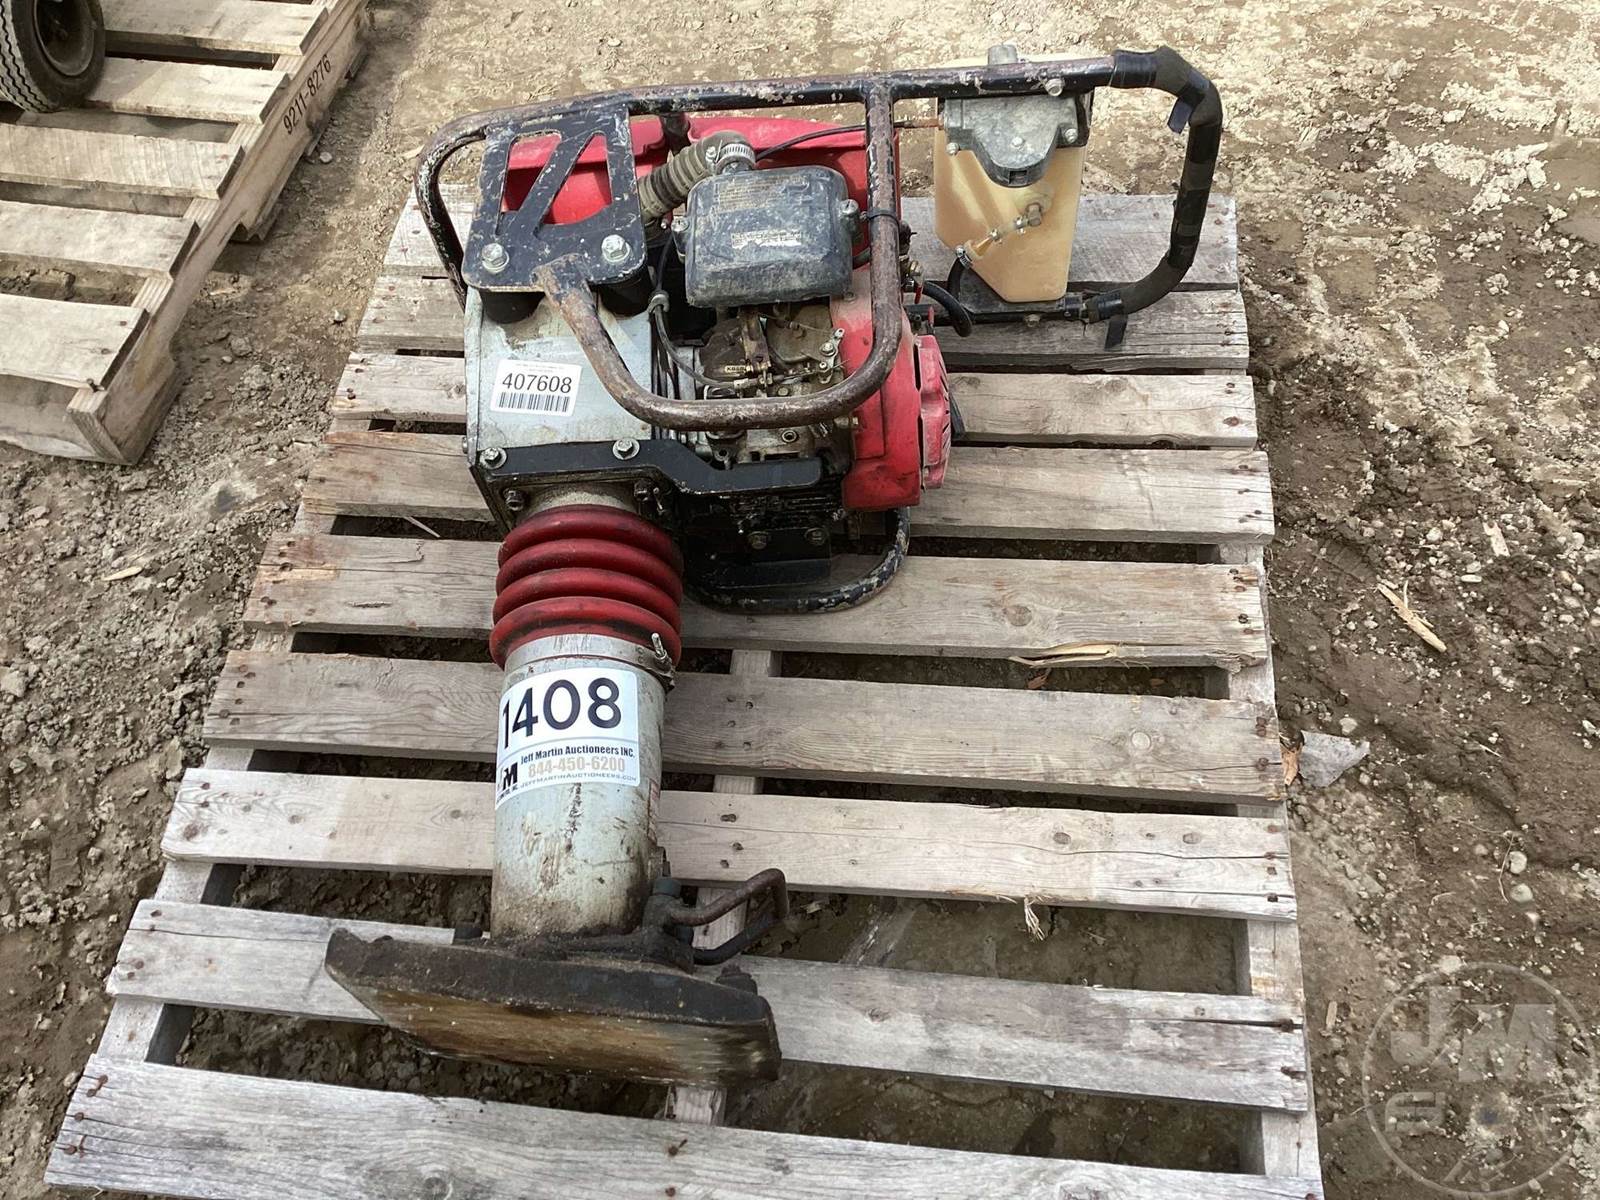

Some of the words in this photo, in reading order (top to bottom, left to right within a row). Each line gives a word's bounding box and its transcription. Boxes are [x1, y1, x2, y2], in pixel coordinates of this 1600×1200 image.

[283, 54, 331, 135] 9211-8276
[502, 373, 572, 393] 407608
[502, 677, 622, 750] 1408
[521, 754, 534, 765] Jeff
[535, 748, 563, 760] Martin
[565, 744, 619, 755] Auctioneers
[528, 756, 625, 778] 844-450-6200
